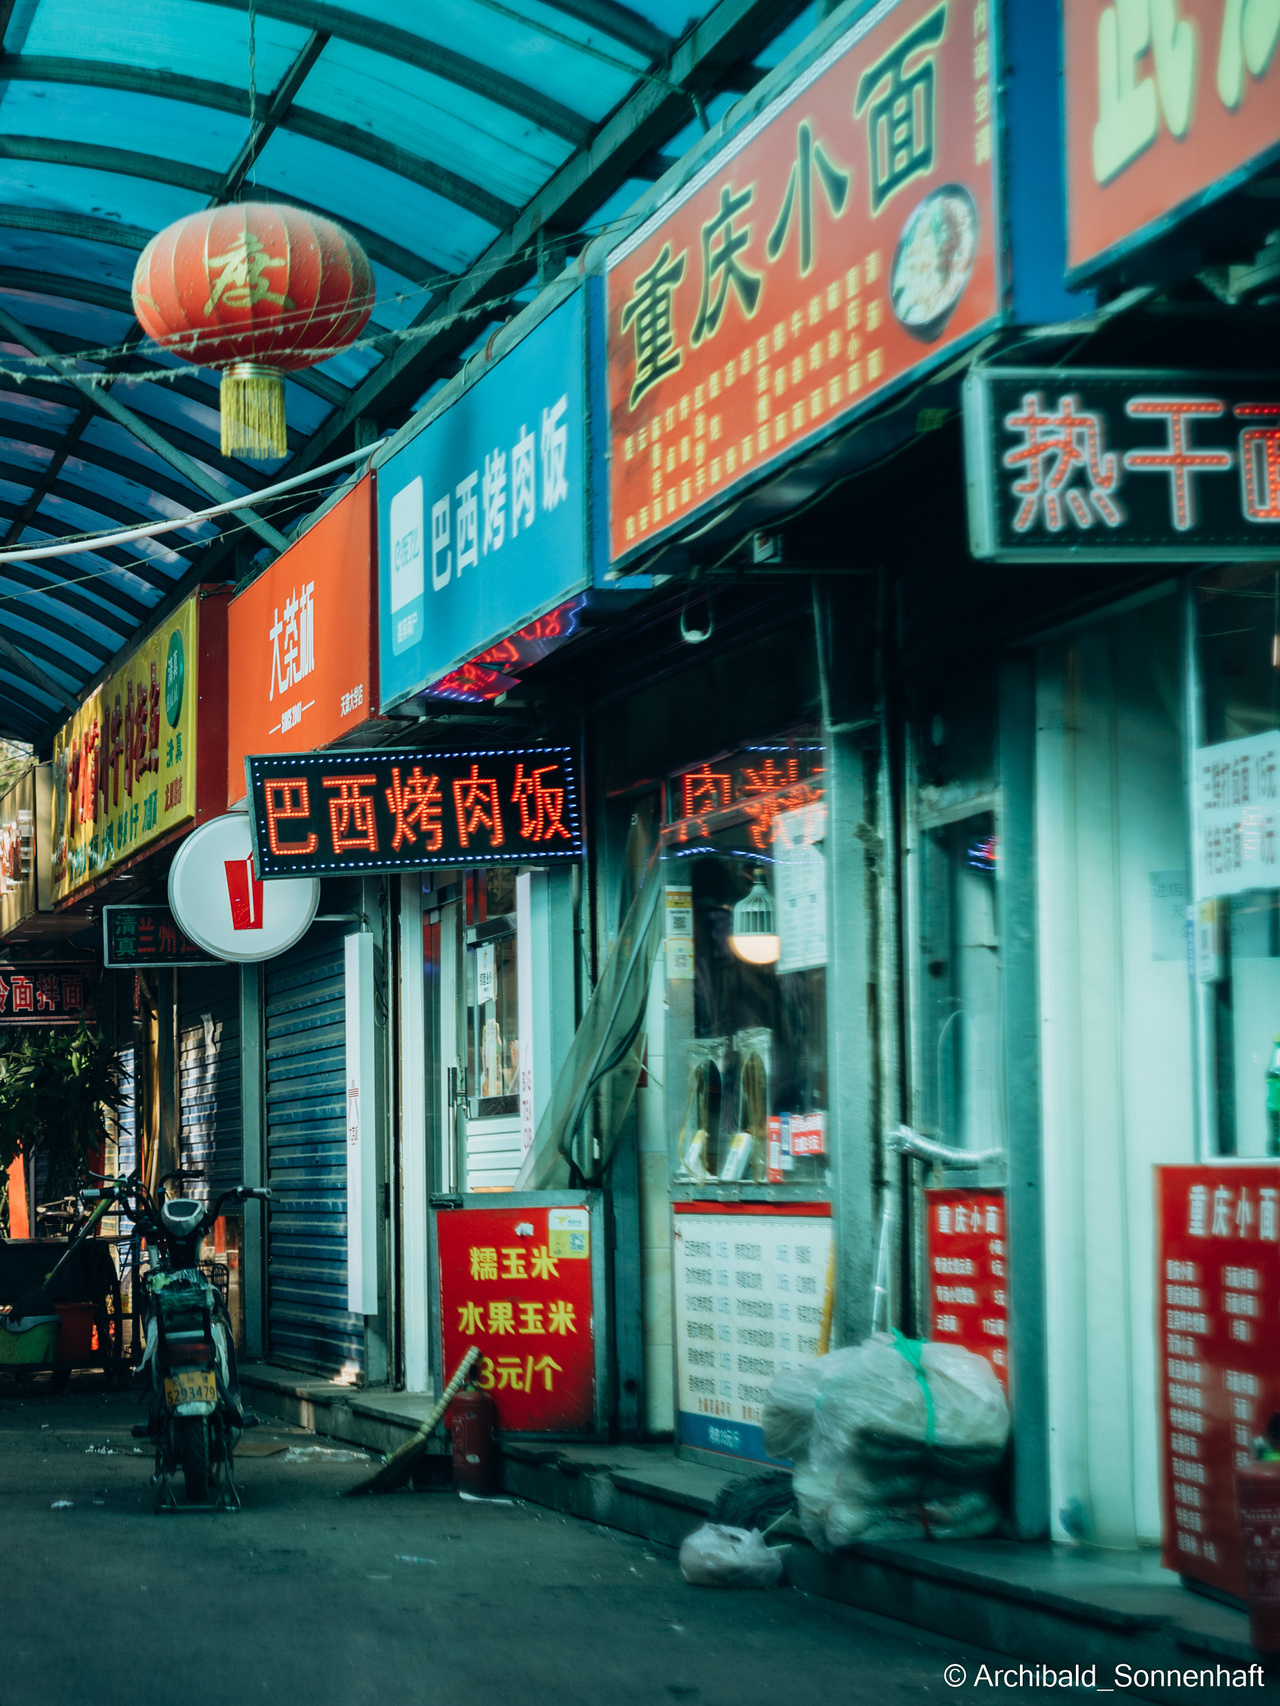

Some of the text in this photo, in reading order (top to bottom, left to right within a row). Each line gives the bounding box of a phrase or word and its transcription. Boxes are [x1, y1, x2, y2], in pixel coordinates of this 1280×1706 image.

[620, 1, 948, 411] 重庆小面
[431, 393, 568, 592] 巴西烤肉饭
[341, 683, 364, 718] 天津大学店
[264, 764, 572, 855] 巴西烤肉饭
[115, 915, 138, 957] 清真
[939, 1205, 999, 1234] 重庆小面
[1189, 1185, 1277, 1241] 重庆小面
[470, 1245, 560, 1280] 糯玉米
[1166, 1260, 1194, 1281] 重庆小面
[457, 1301, 577, 1336] 水果玉米
[476, 1355, 563, 1393] 3元/个
